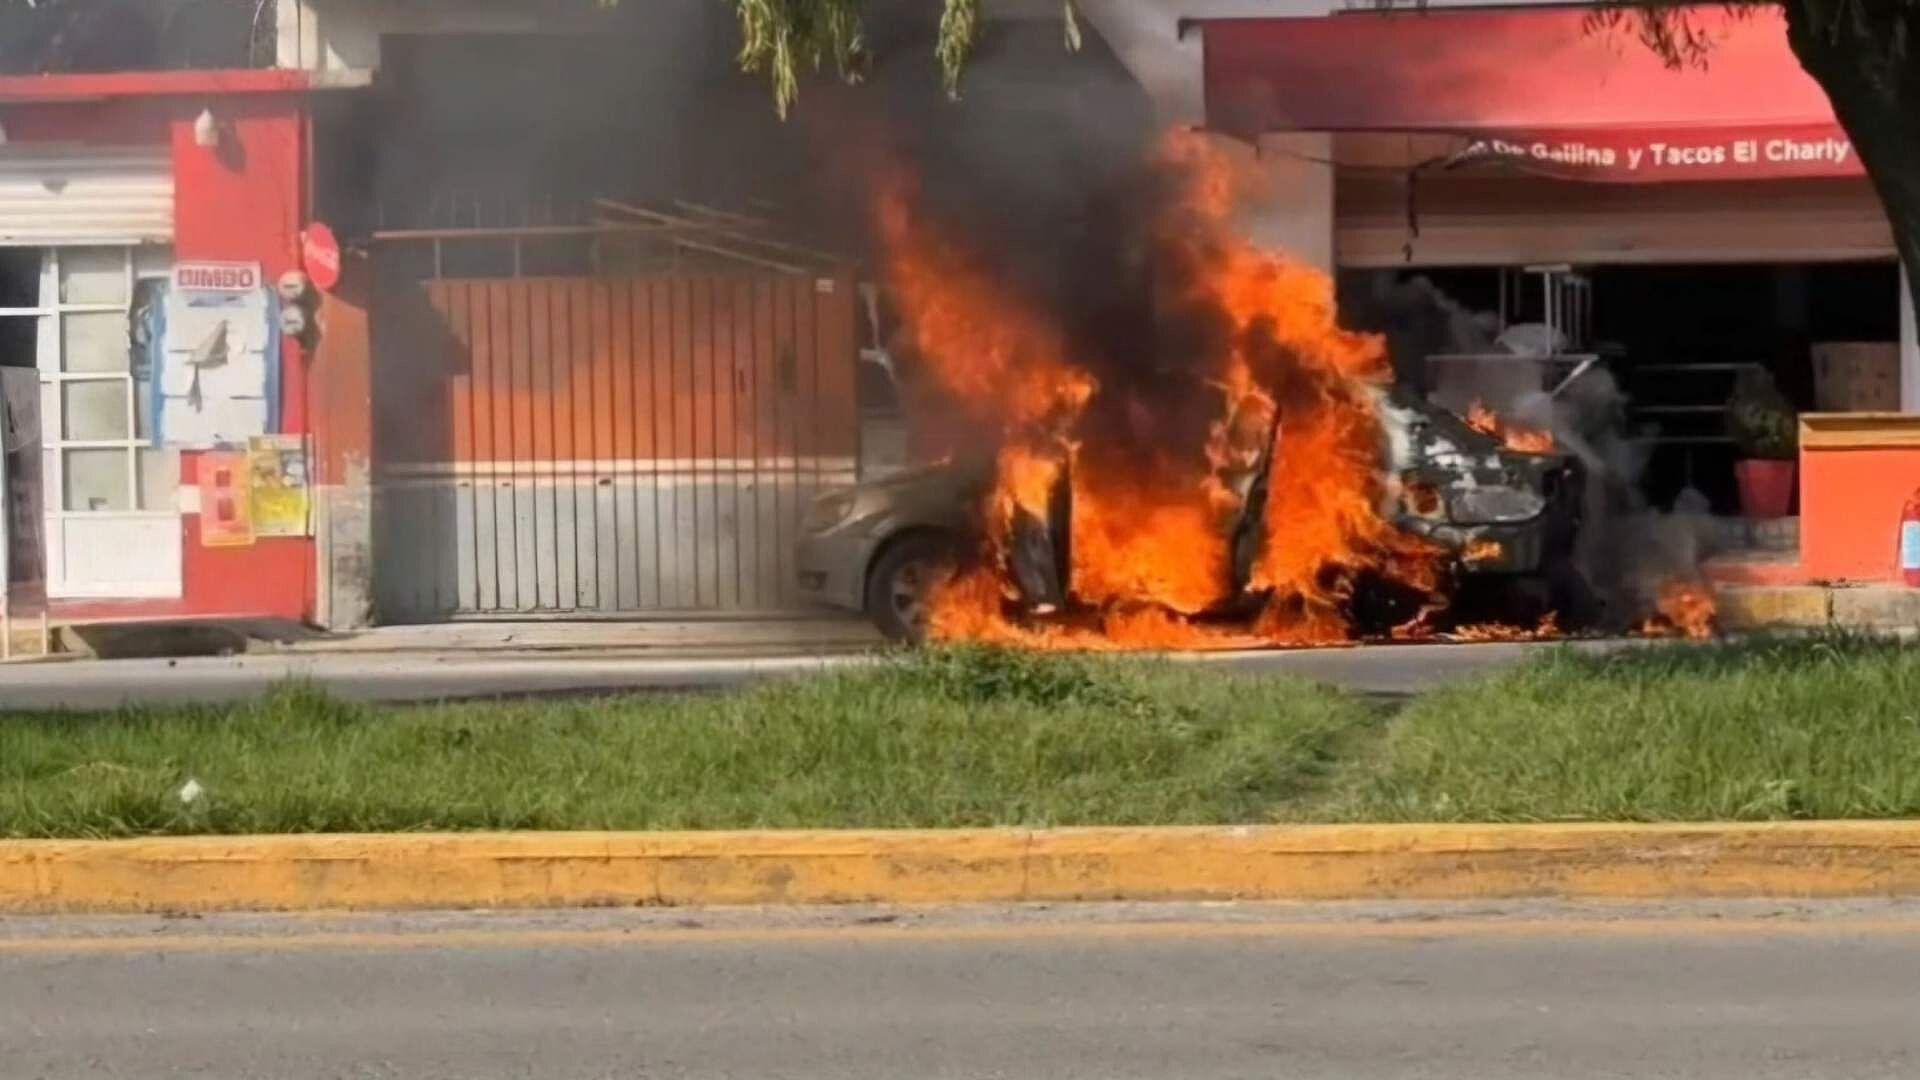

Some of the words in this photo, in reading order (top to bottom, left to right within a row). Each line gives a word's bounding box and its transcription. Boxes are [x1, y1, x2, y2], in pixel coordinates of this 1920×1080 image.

[1627, 147, 1643, 170] y
[1651, 143, 1726, 165] Tacos
[1733, 140, 1757, 163] El
[1765, 138, 1850, 164] Charly
[178, 269, 254, 288] BIMBO
